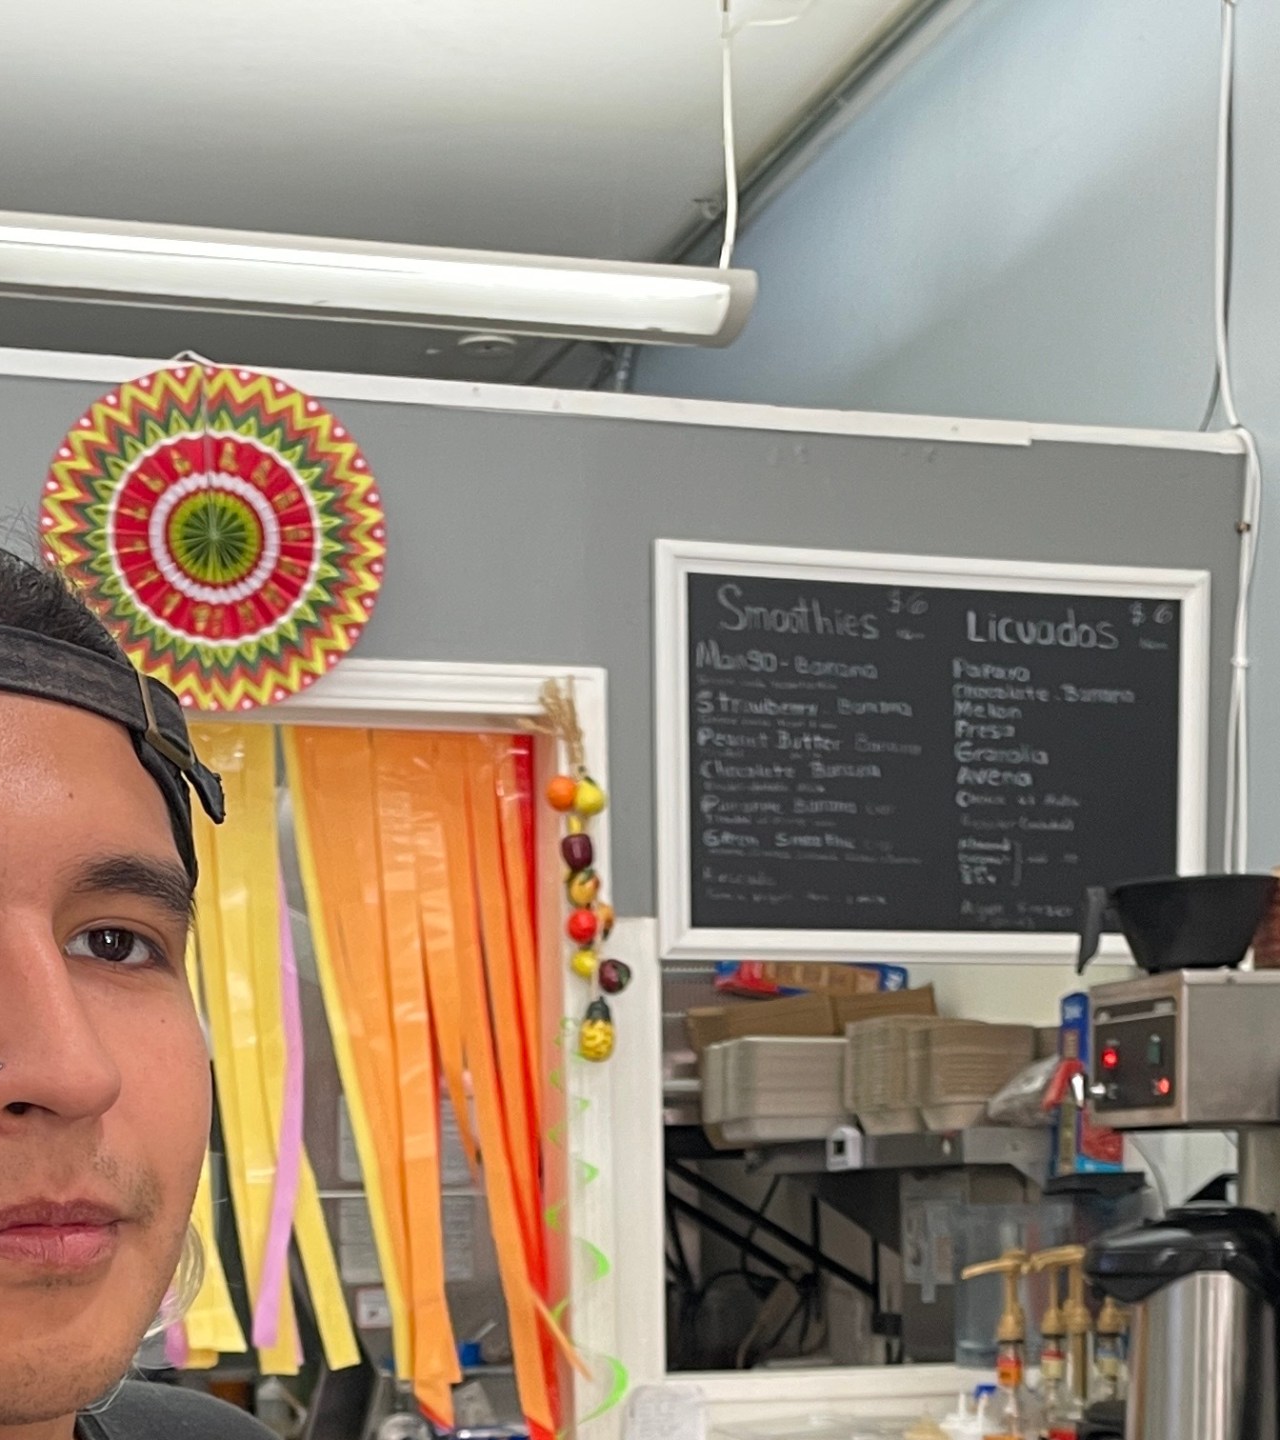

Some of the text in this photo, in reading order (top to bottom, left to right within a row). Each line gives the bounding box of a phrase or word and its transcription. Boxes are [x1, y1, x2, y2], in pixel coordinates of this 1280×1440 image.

[716, 583, 880, 640] Smoothies
[966, 607, 1120, 650] Licuados
[954, 719, 1016, 740] Fresa
[956, 766, 1034, 787] Avena
